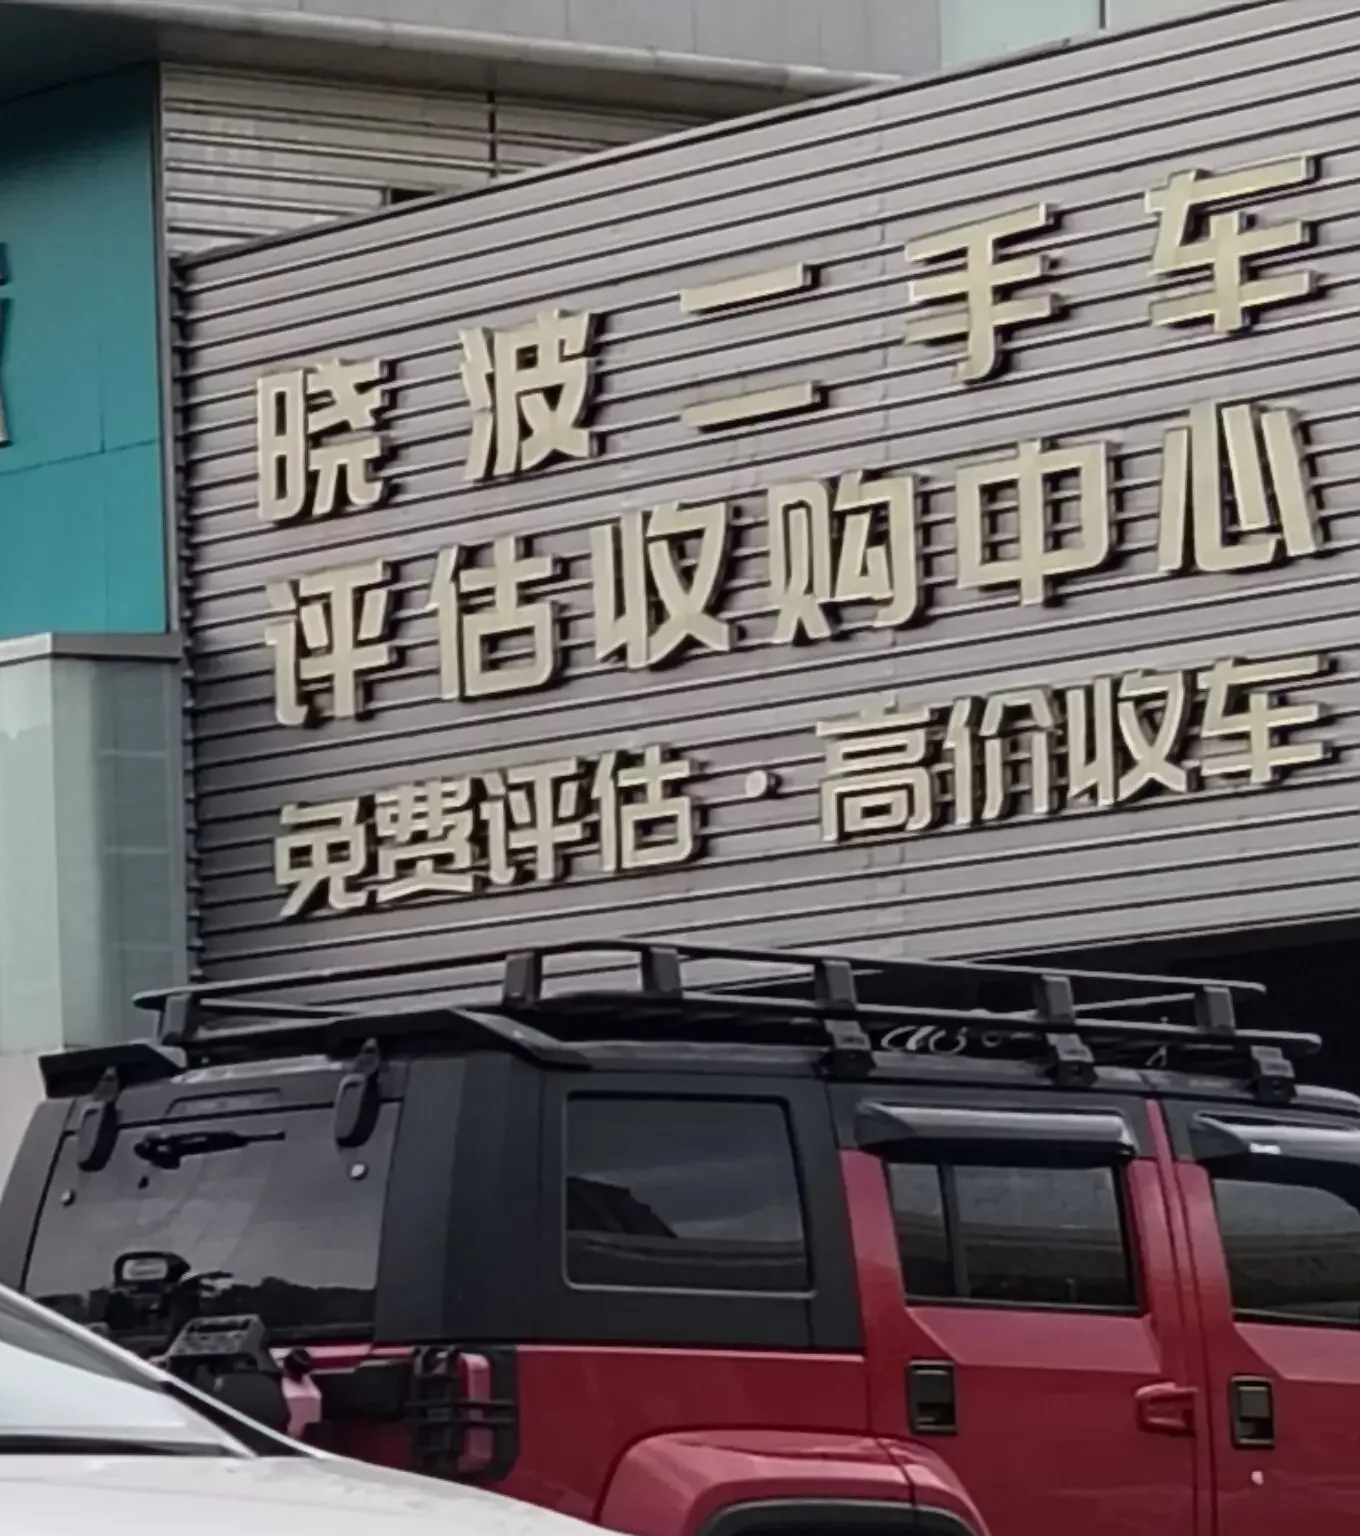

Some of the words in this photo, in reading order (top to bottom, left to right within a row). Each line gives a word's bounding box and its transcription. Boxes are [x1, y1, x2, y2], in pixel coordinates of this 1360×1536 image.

[256, 154, 1320, 526] 晓波二手车
[265, 402, 1326, 730] 评估收购中心
